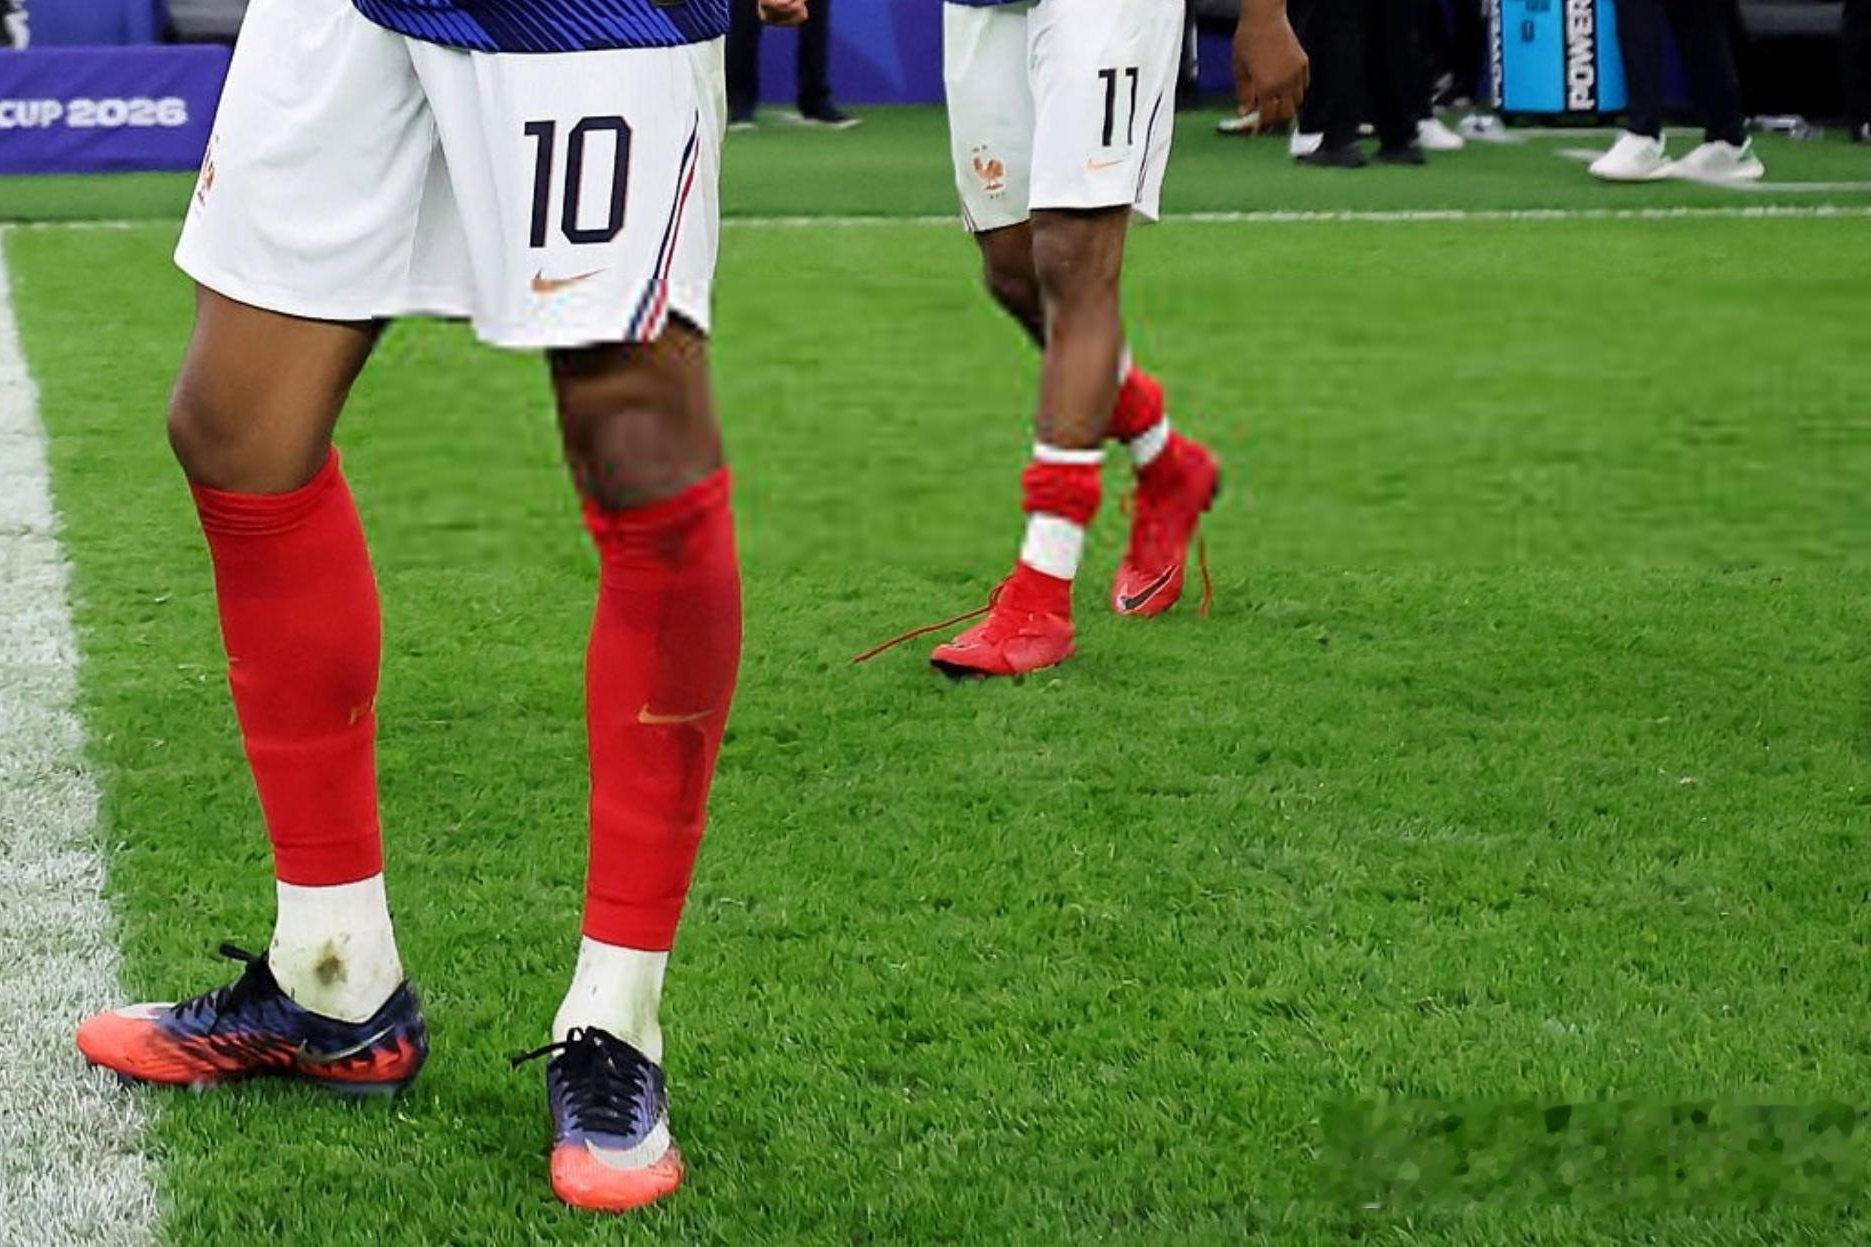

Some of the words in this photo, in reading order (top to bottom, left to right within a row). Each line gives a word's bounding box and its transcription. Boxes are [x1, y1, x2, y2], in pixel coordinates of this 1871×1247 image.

[66, 97, 188, 128] 2026
[1098, 66, 1139, 148] 11
[524, 115, 633, 248] 10
